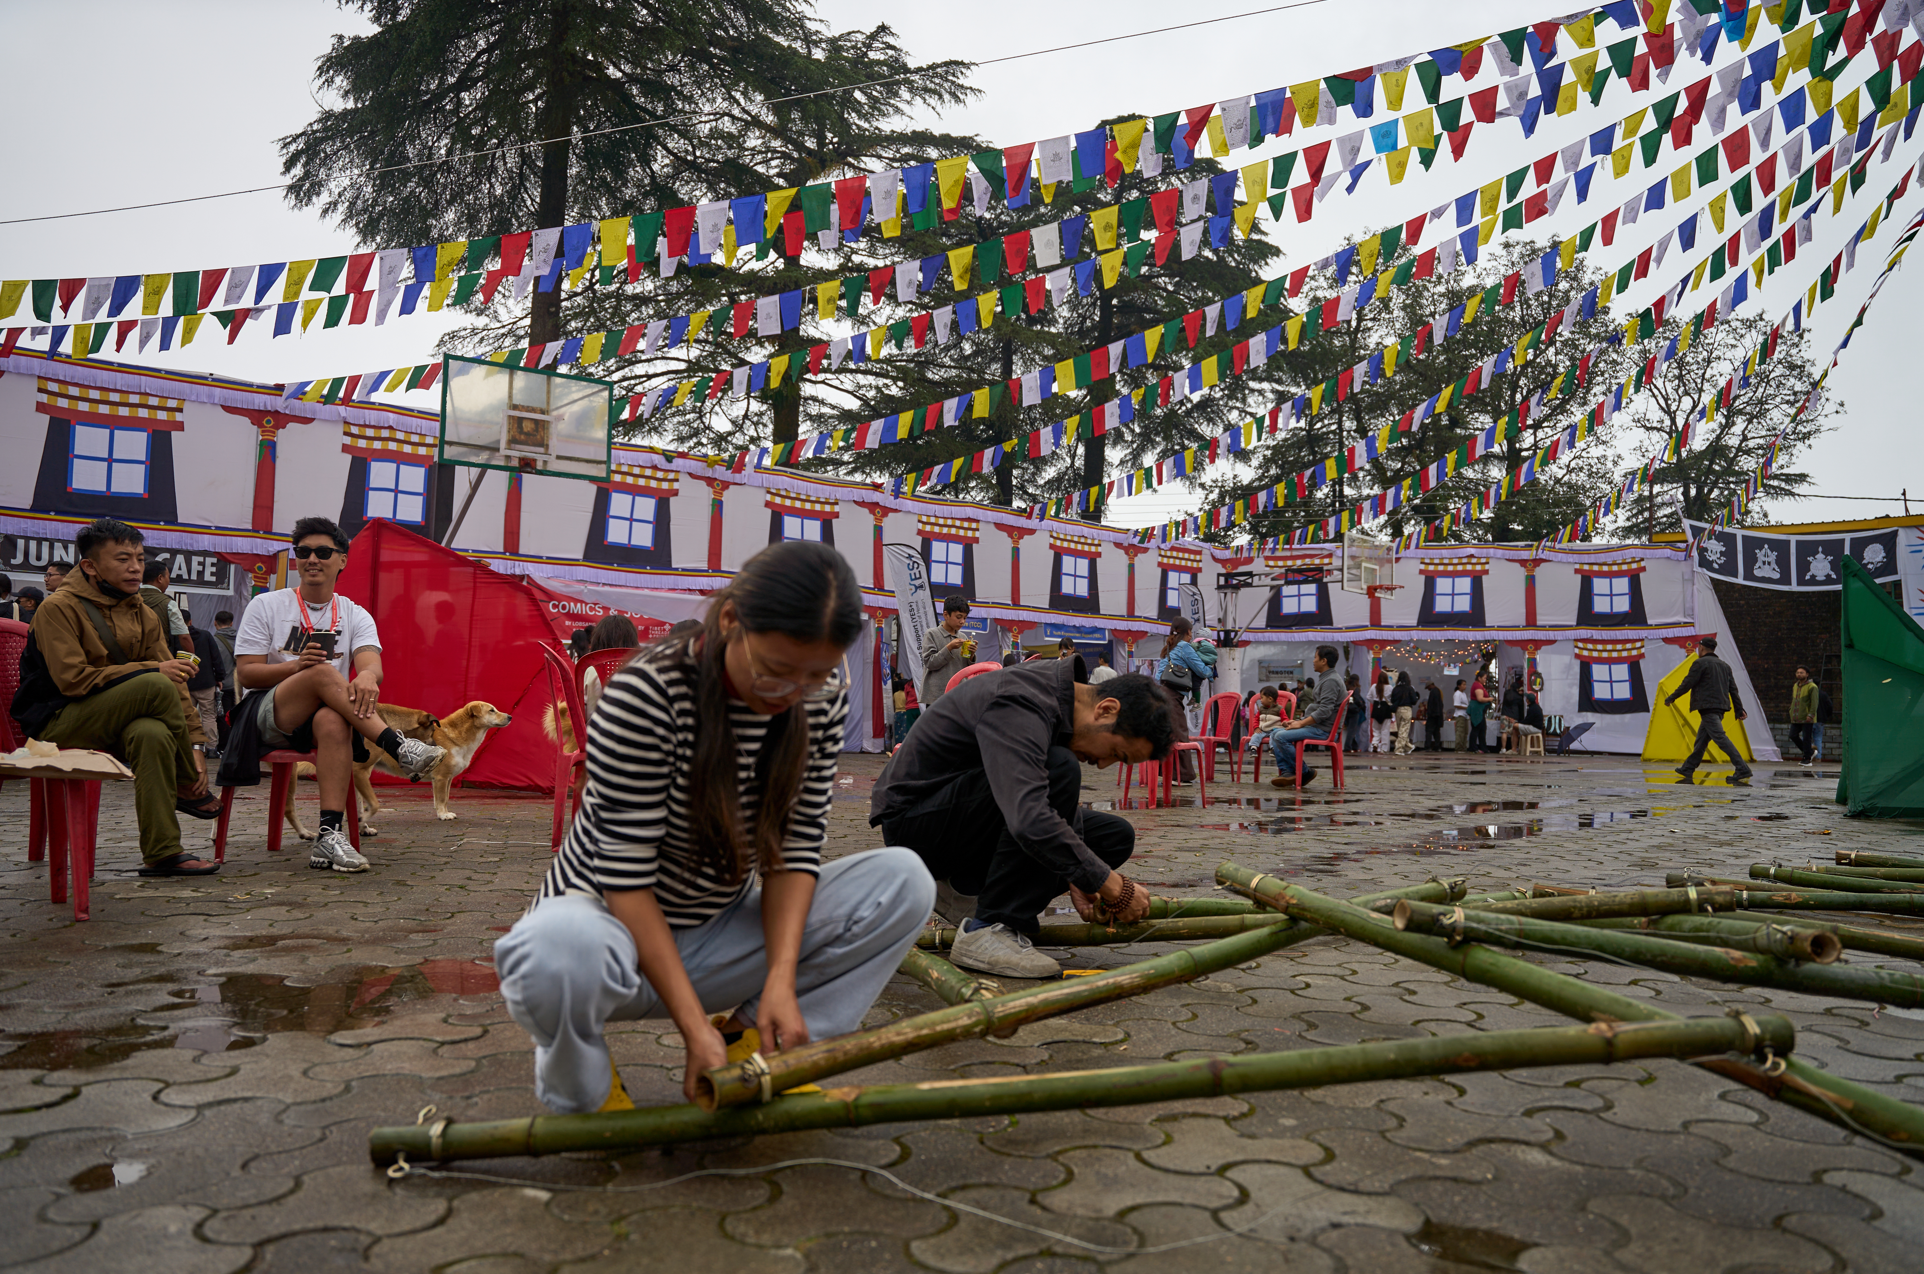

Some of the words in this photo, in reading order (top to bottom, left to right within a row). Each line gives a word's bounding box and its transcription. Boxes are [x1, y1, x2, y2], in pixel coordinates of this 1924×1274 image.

[10, 538, 82, 567] JUN
[549, 601, 604, 615] COMICS
[969, 621, 982, 629] (TCC)
[914, 623, 922, 650] Support
